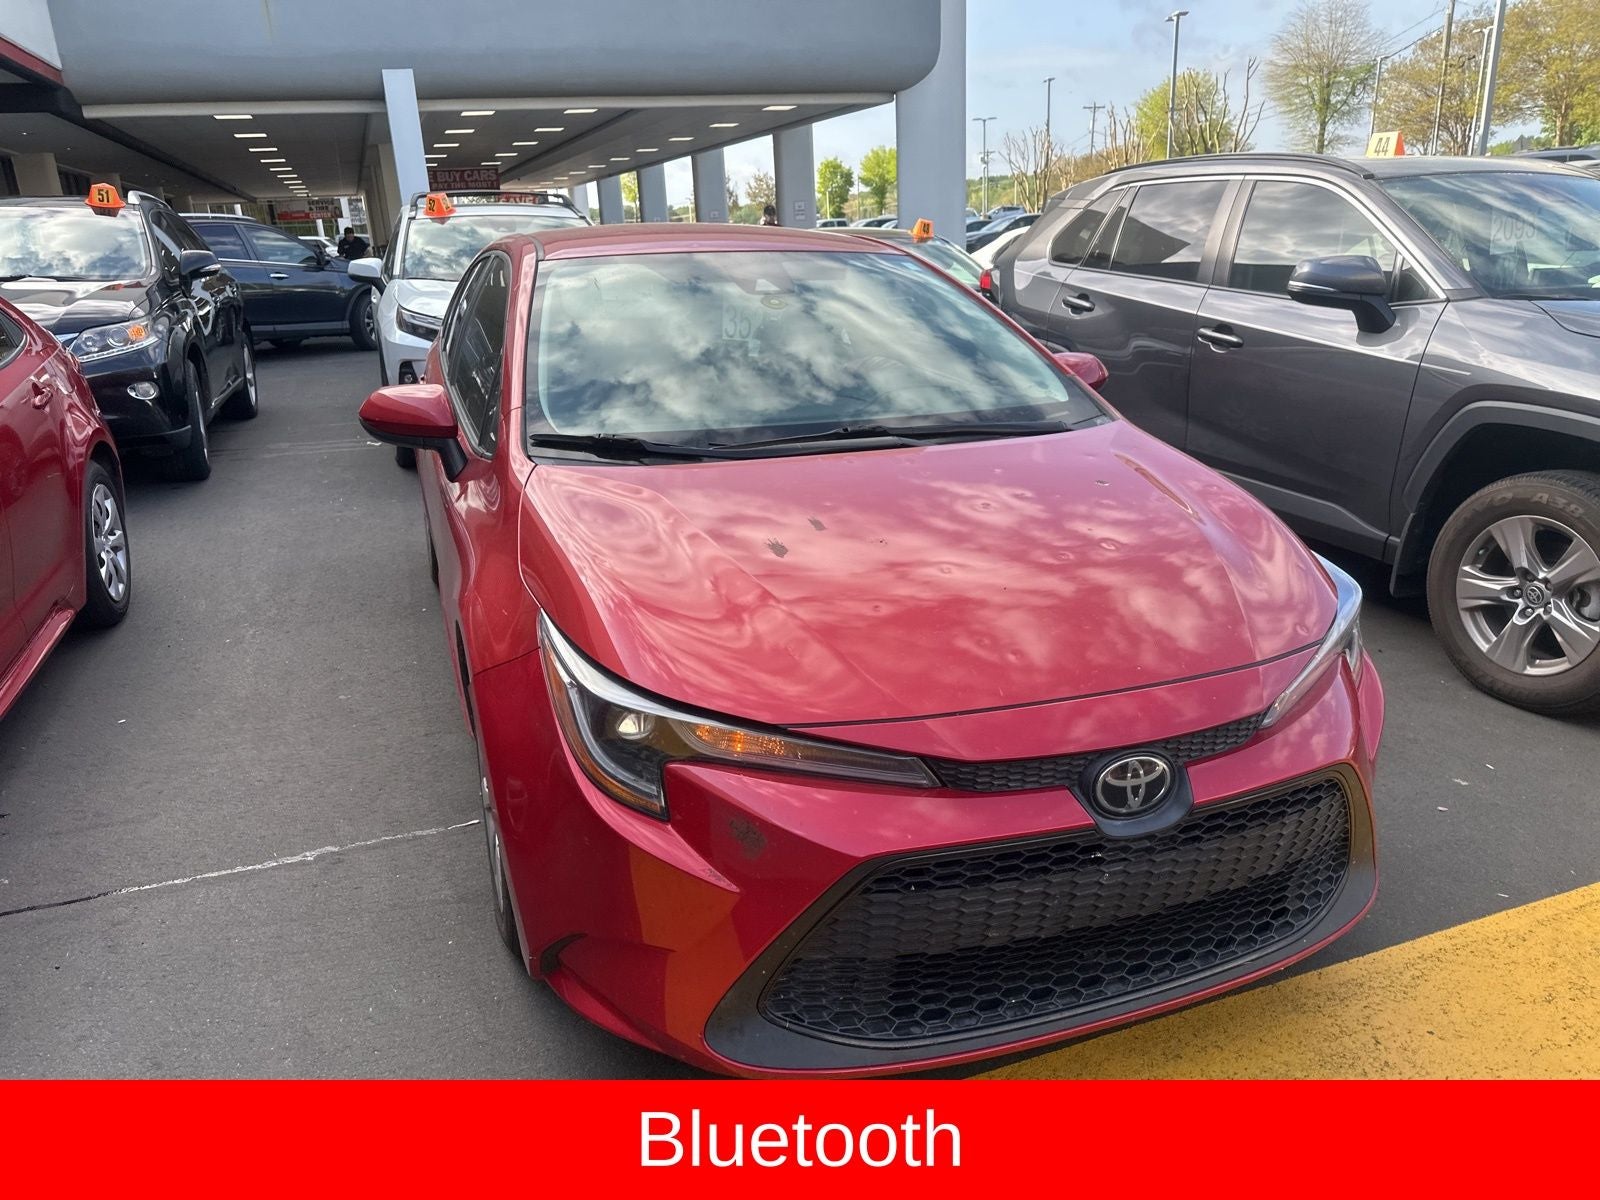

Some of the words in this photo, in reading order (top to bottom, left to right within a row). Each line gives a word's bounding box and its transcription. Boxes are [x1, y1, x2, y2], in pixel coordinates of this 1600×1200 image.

[1374, 136, 1391, 157] 44
[436, 171, 461, 183] BUY
[464, 170, 497, 181] CARS
[97, 189, 110, 203] 51
[428, 198, 436, 212] 52
